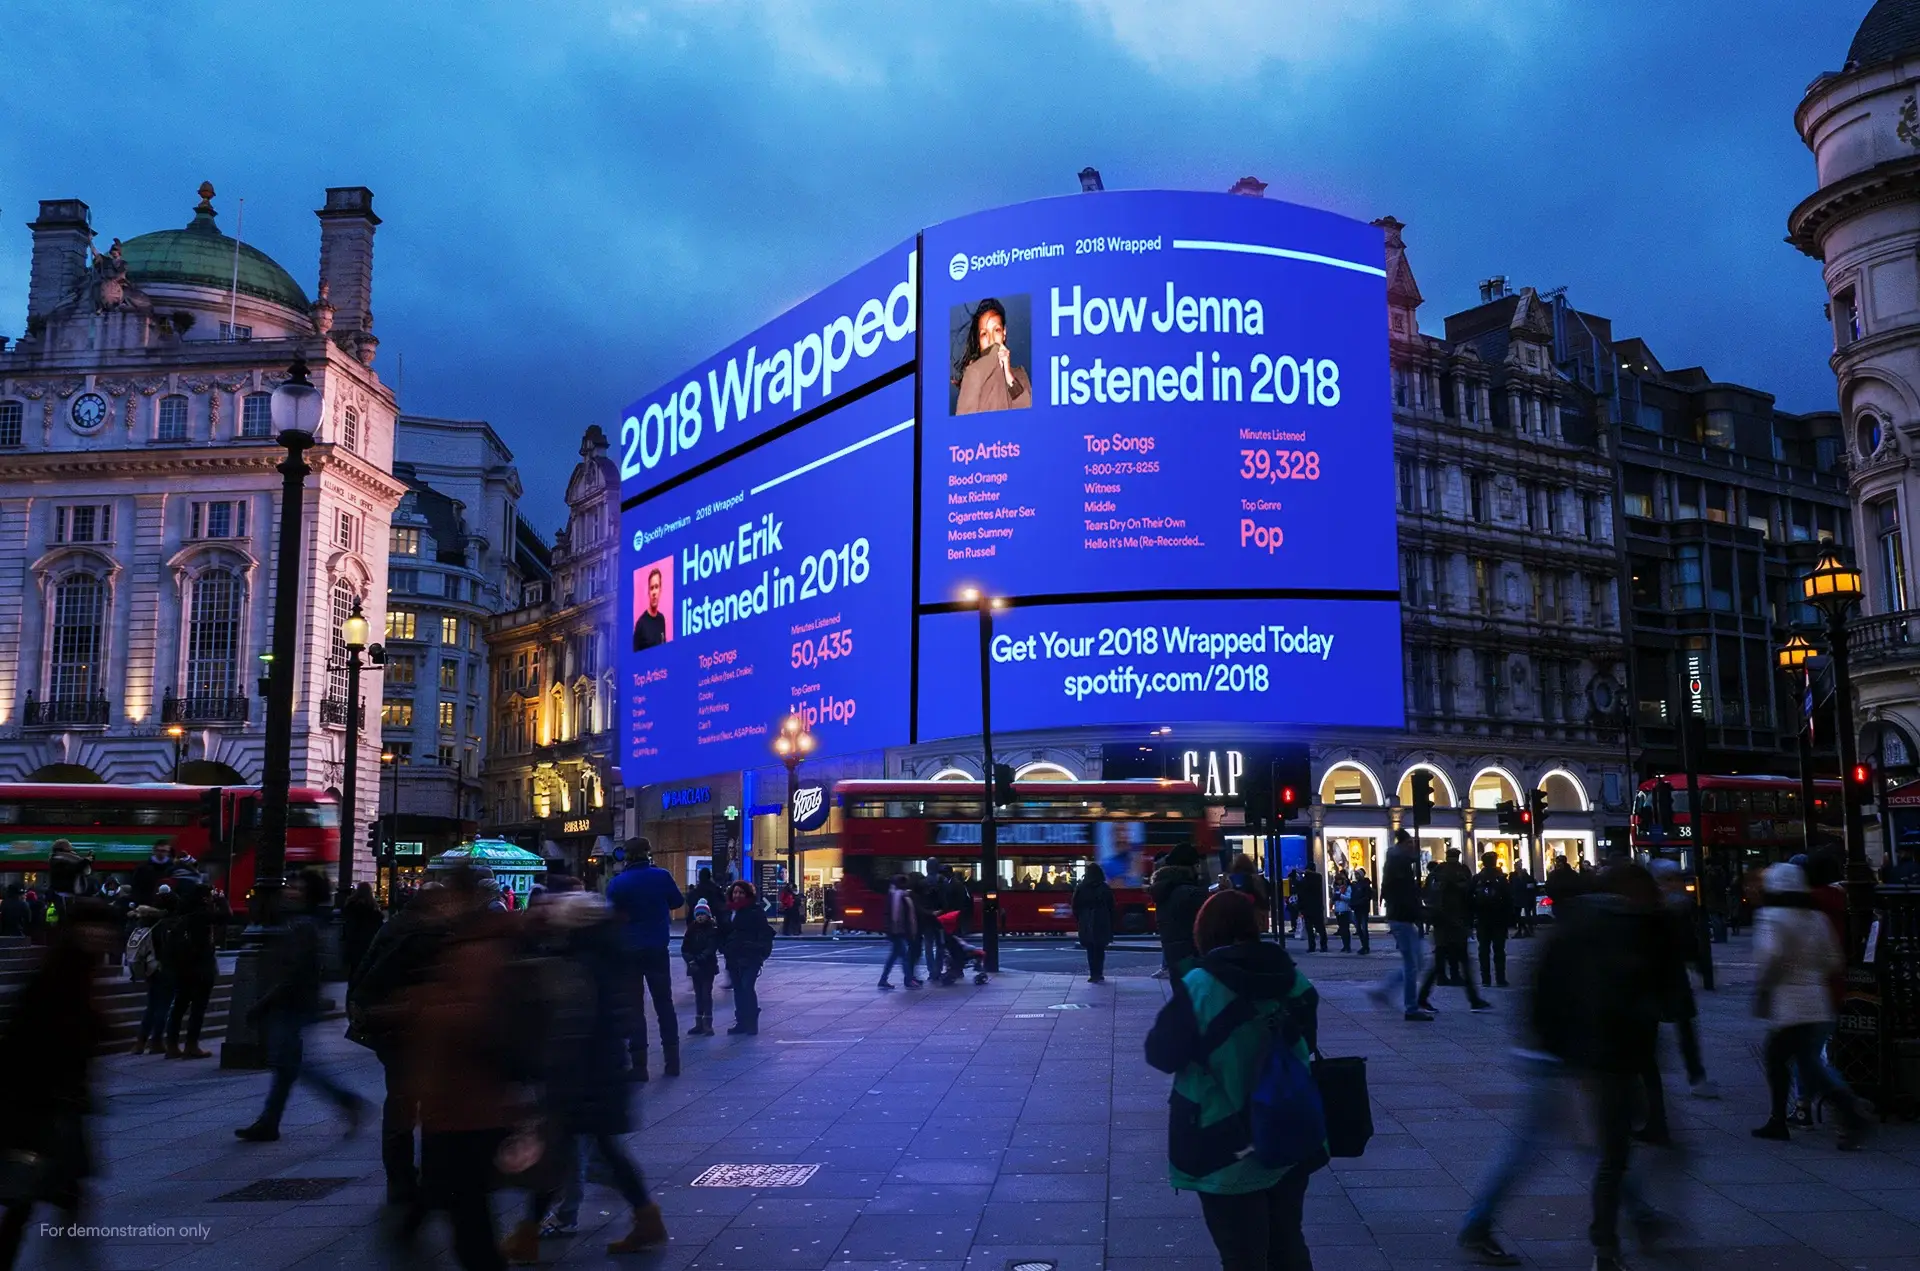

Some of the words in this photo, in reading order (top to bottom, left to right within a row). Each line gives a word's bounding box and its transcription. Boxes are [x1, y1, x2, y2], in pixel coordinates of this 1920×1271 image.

[971, 250, 1010, 271] Spotify
[1011, 242, 1064, 263] Premium
[1075, 238, 1105, 255] 2018
[1107, 236, 1161, 256] Wrapped
[1051, 285, 1147, 337] How
[1152, 281, 1264, 335] Jenna
[621, 380, 702, 482] 2018
[707, 249, 917, 433] Wrapped
[1051, 351, 1202, 406] listened
[1212, 351, 1243, 402] in
[1250, 354, 1340, 407] 2018
[1084, 434, 1111, 455] Top
[1113, 433, 1155, 455] Songs
[1240, 428, 1272, 441] Minutes
[1273, 429, 1306, 442] Listened
[949, 444, 974, 465] Top
[976, 440, 1020, 460] Artists
[1084, 461, 1160, 476] 1-800-273-8255
[1240, 449, 1320, 483] 39,328
[949, 474, 973, 486] Blood
[974, 471, 1008, 485] Orange
[1084, 483, 1121, 494] Witness
[949, 493, 967, 505] Max
[968, 491, 1000, 503] Richter
[1084, 501, 1116, 513] Middle
[1241, 499, 1257, 514] Top
[1258, 499, 1282, 512] Genre
[643, 527, 664, 545] Spotify
[664, 515, 691, 535] Premium
[695, 504, 712, 521] 2018
[712, 490, 745, 512] Wrapped
[949, 510, 994, 525] Cigarettes
[994, 507, 1018, 519] After
[1019, 506, 1036, 518] Sex
[1085, 520, 1109, 532] Tears
[1109, 519, 1126, 532] Dry
[1126, 518, 1141, 529] On
[1142, 517, 1164, 529] Their
[1164, 517, 1186, 529] Own
[949, 529, 977, 541] Moses
[978, 526, 1014, 540] Sumney
[1085, 538, 1108, 550] Hello
[1123, 537, 1138, 548] Me
[1240, 518, 1284, 554] Pop
[682, 538, 735, 586] How
[738, 512, 784, 566] Erik
[948, 548, 965, 560] Ben
[966, 545, 996, 558] Russell
[682, 571, 769, 637] listened
[773, 566, 795, 609] in
[800, 537, 870, 600] 2018
[791, 621, 815, 636] Minutes
[814, 612, 841, 630] Listened
[791, 629, 853, 669] 50,435
[991, 633, 1036, 662] Get
[1040, 630, 1094, 659] Your
[1099, 628, 1159, 656] 2018
[1162, 625, 1266, 660] Wrapped
[1268, 625, 1334, 660] Today
[699, 653, 713, 670] Top
[712, 648, 738, 666] Songs
[633, 673, 645, 687] Top
[791, 685, 803, 697] Top
[802, 682, 821, 694] Genre
[1064, 663, 1270, 701] spotify.com/2018
[820, 695, 856, 726] Hop
[1183, 750, 1243, 796] GAP
[672, 786, 711, 805] BARCLAYS
[793, 786, 823, 823] Boots
[1679, 826, 1692, 837] 38
[496, 874, 533, 893] CKED
[1839, 1014, 1877, 1030] FREE
